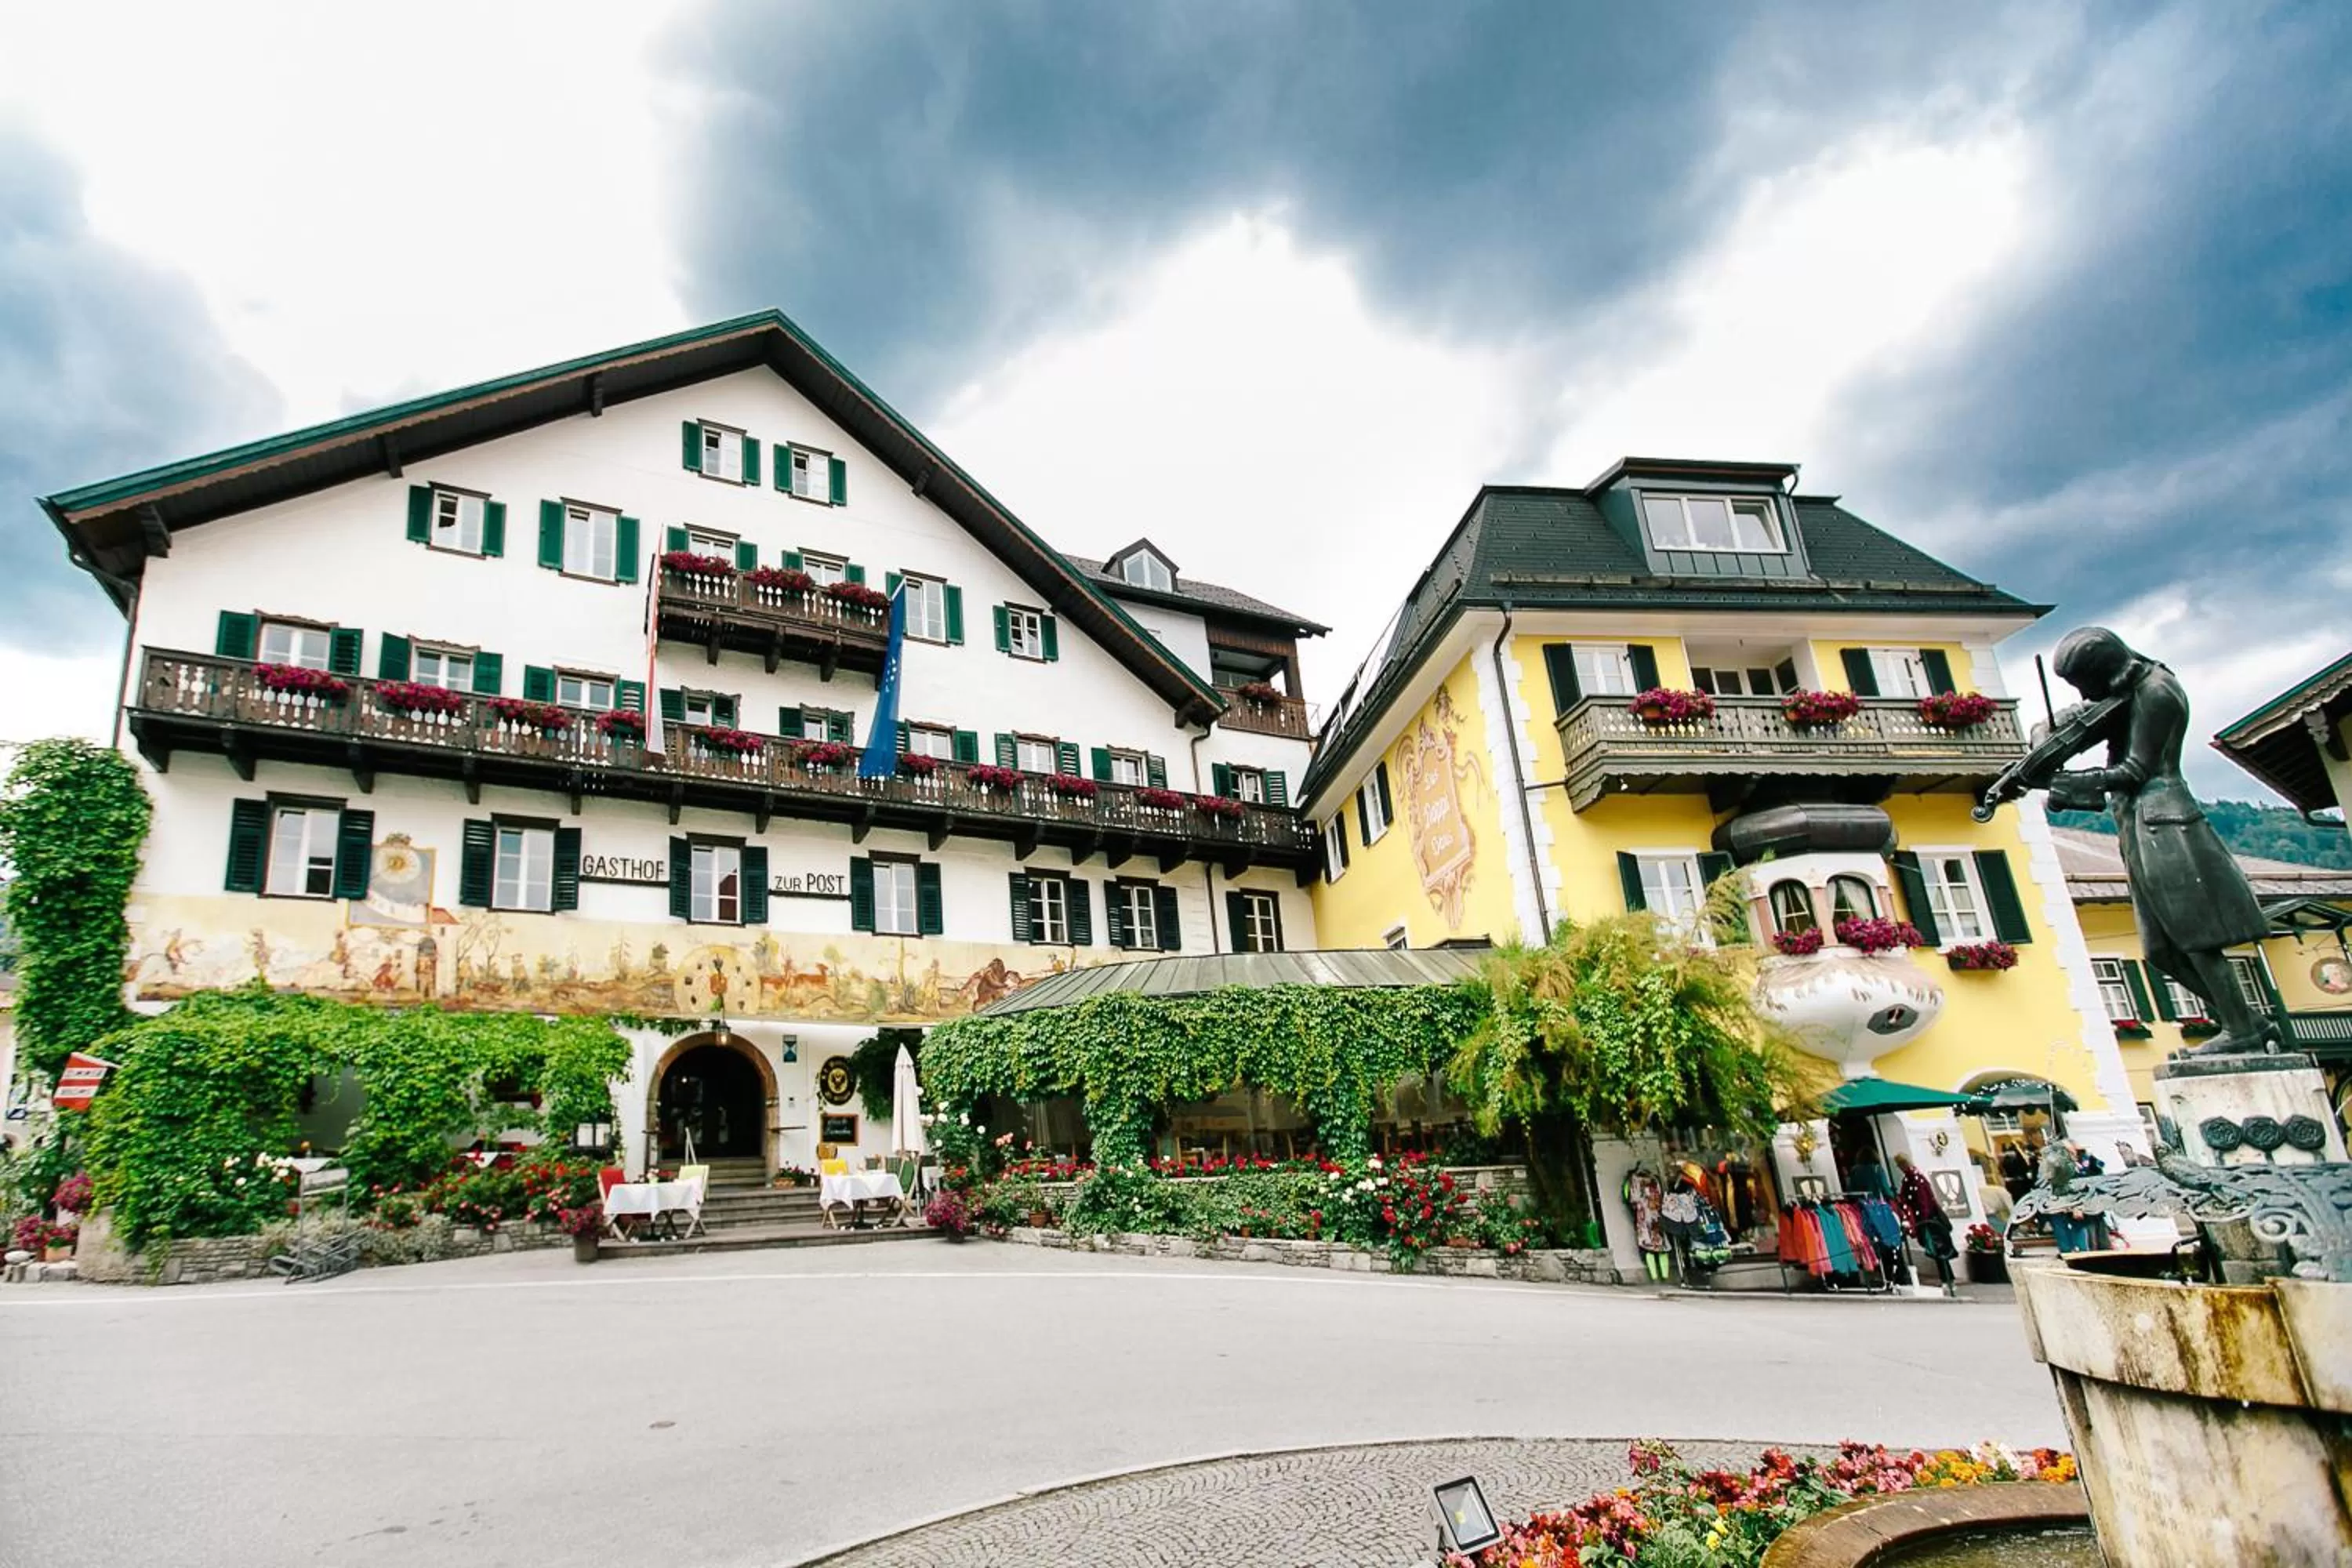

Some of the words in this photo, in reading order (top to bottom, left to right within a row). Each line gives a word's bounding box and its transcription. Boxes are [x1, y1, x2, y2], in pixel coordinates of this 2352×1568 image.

[583, 854, 664, 881] GASTHOF
[774, 875, 802, 891] ZUR
[806, 872, 845, 894] POST
